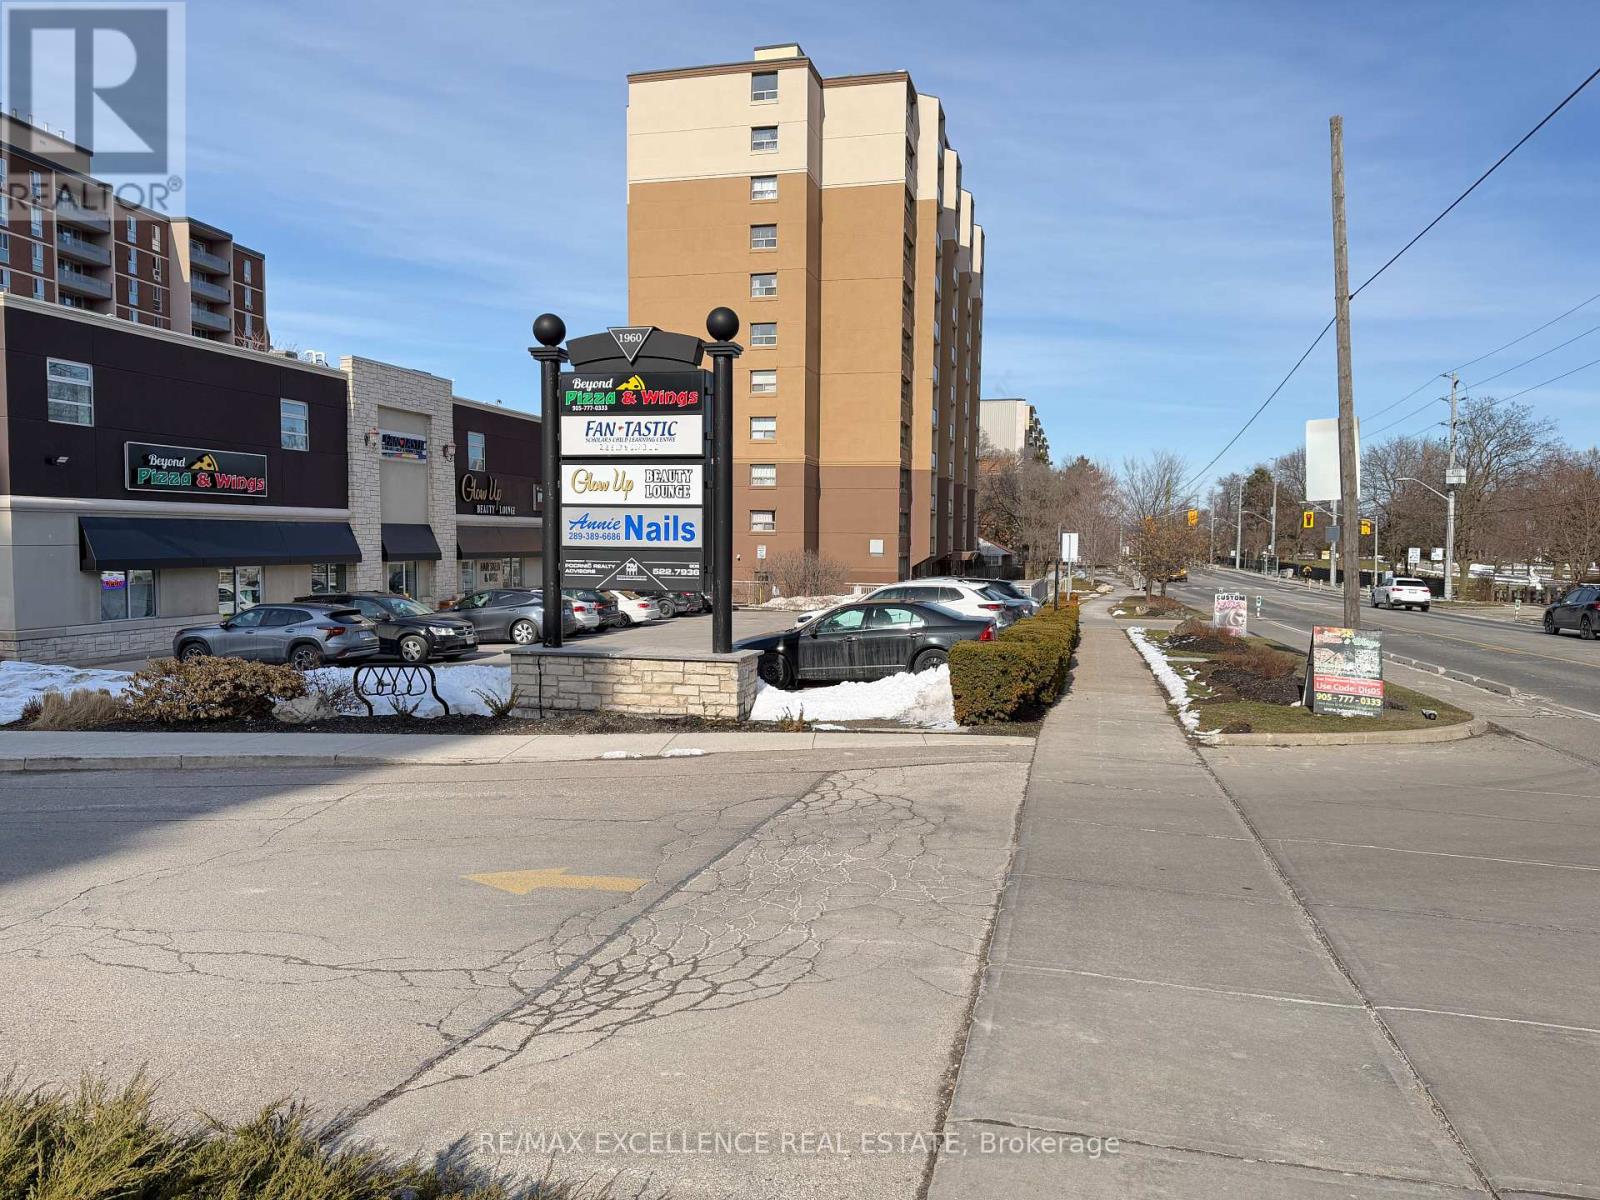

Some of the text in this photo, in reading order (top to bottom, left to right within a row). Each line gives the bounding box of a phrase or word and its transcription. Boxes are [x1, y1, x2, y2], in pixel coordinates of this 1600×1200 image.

[619, 333, 642, 343] 1960
[572, 378, 614, 391] Beyond
[565, 389, 699, 407] Pizza & Wings
[148, 453, 186, 469] Beyond
[137, 467, 265, 493] Pizza & Wings
[645, 469, 693, 483] BEAUTY
[461, 473, 502, 511] Glow Up
[571, 468, 634, 501] Glow Up
[645, 484, 690, 499] LOUNGE
[476, 504, 516, 515] BEAUTY LOUNGE
[569, 512, 621, 530] Annie
[624, 514, 696, 542] Nails
[569, 532, 621, 541] 289-389-6686
[1316, 682, 1331, 690] Use
[1333, 684, 1357, 693] Code:
[1316, 693, 1332, 701] 905
[1338, 695, 1355, 703] 777
[1360, 697, 1381, 706] 0333
